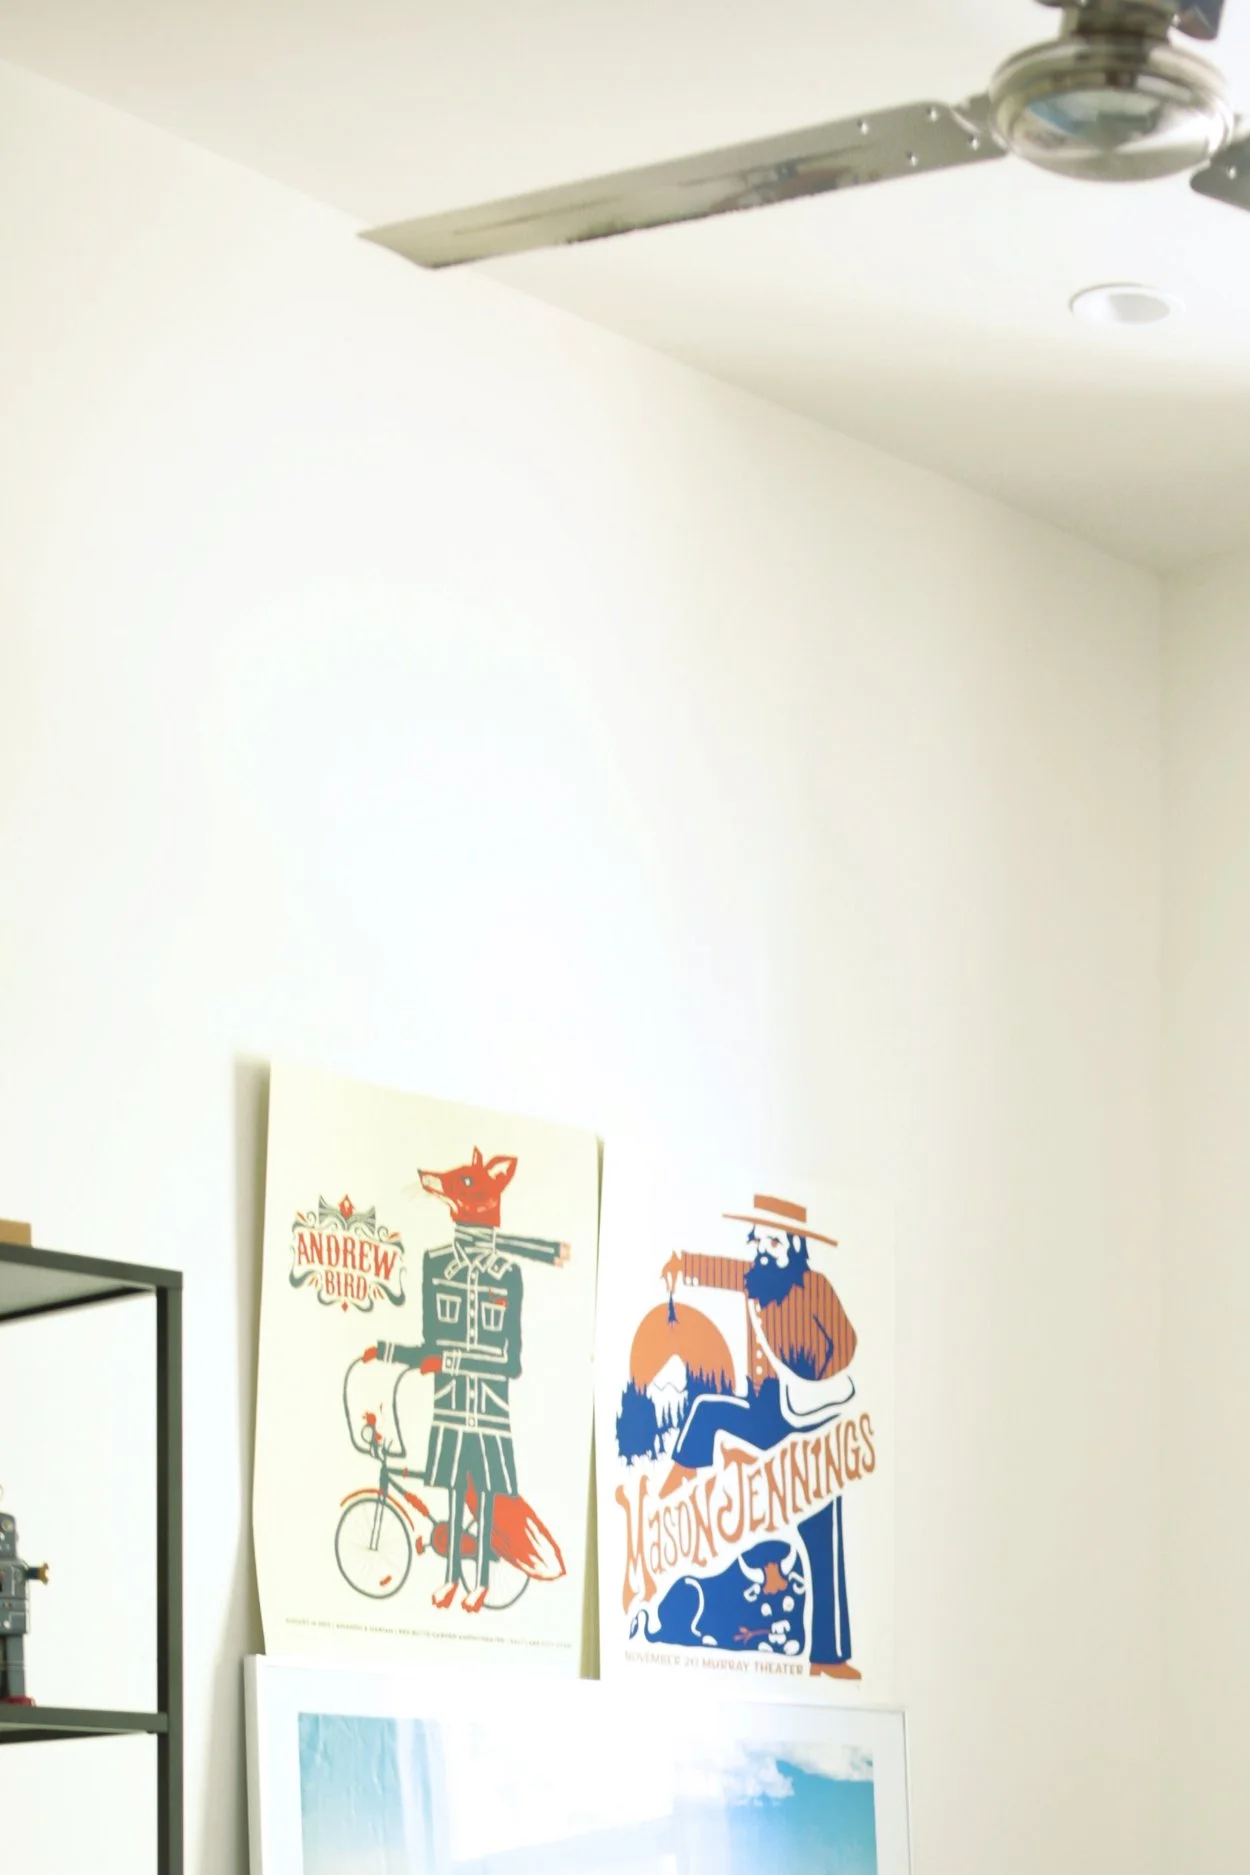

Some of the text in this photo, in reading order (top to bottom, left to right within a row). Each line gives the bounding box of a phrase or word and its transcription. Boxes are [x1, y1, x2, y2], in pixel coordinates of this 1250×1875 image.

[297, 1231, 397, 1280] ANDREW
[325, 1270, 367, 1301] BIRD
[717, 1412, 876, 1543] JENNINGS
[624, 1650, 680, 1666] NOVEMBER
[702, 1658, 749, 1672] MURRAY
[754, 1662, 803, 1676] THEATER
